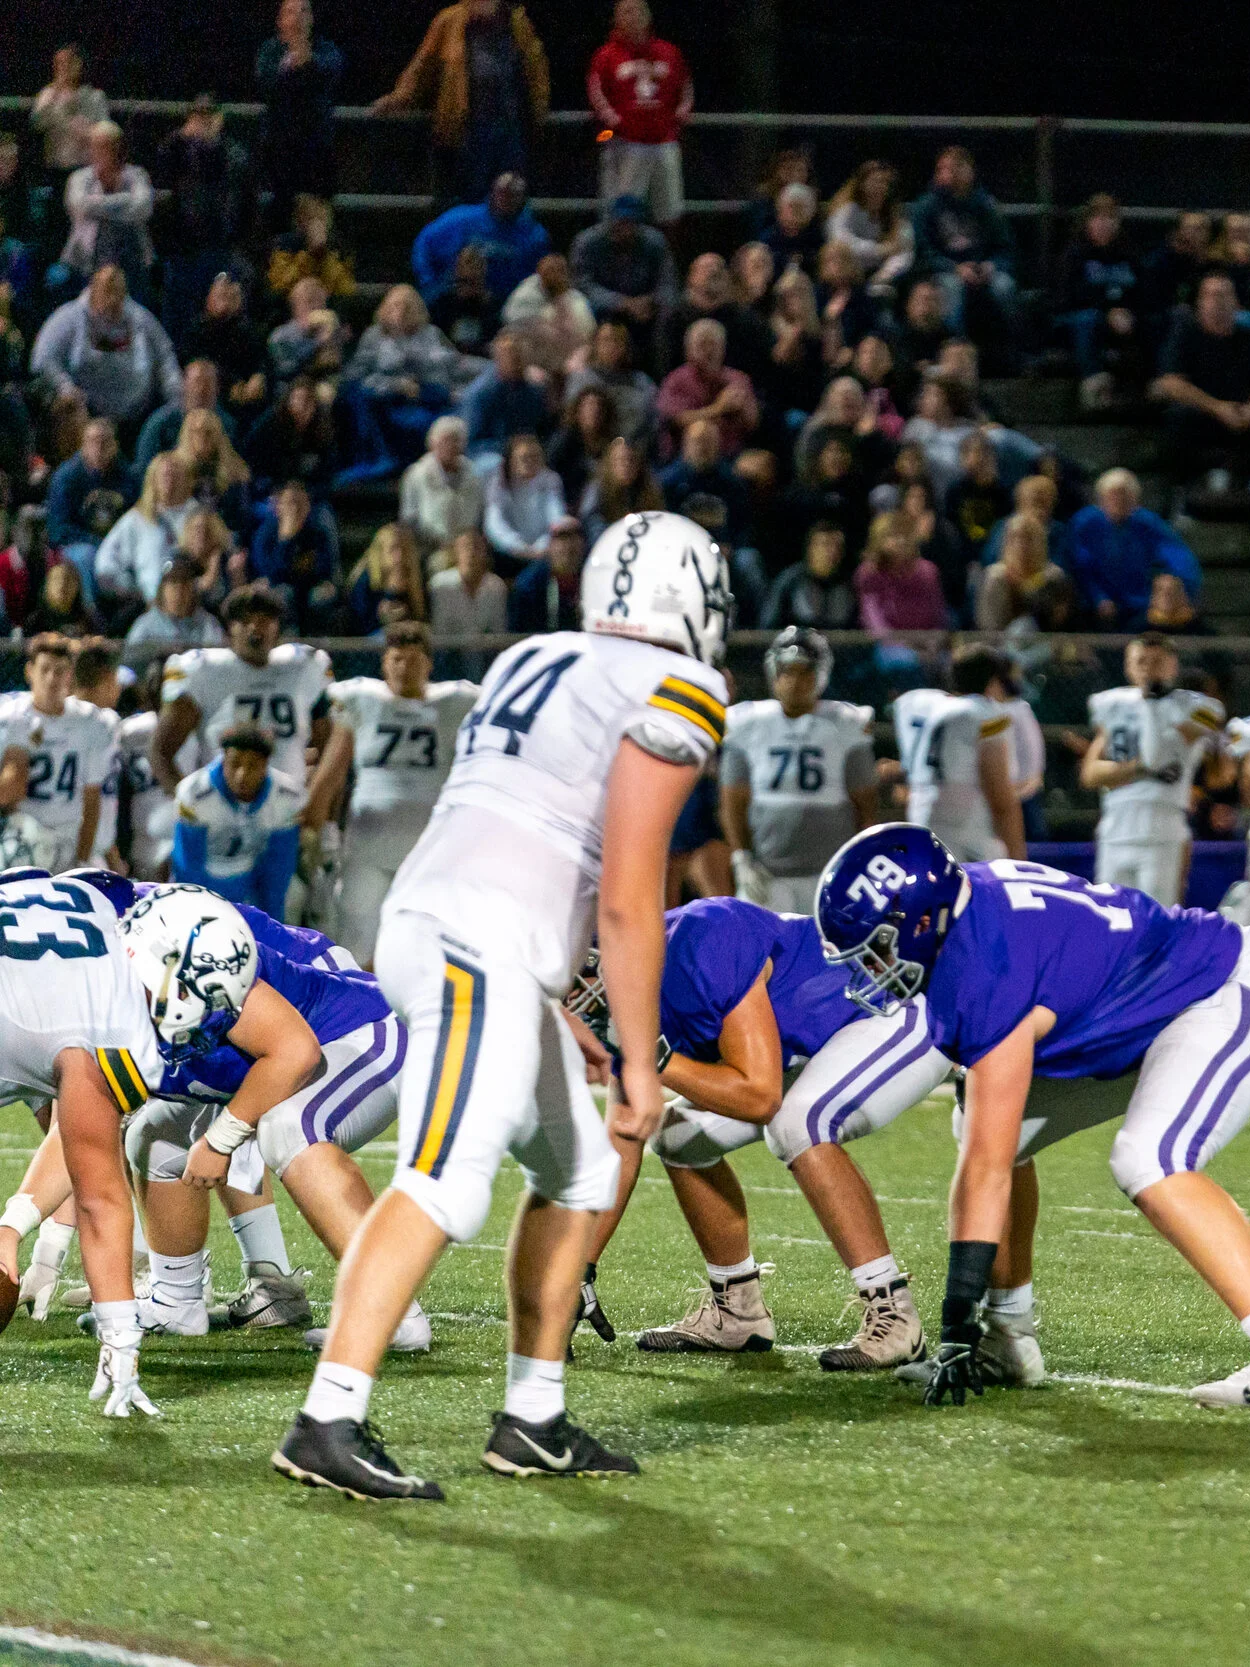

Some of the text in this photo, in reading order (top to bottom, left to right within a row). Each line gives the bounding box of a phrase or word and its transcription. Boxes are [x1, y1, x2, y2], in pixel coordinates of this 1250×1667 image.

[234, 695, 297, 739] 79
[462, 646, 582, 757] 44
[376, 723, 439, 768] 73
[768, 745, 825, 793] 76
[27, 751, 78, 801] 24
[845, 854, 907, 913] 79
[988, 858, 1134, 932] 79
[0, 881, 109, 961] 33
